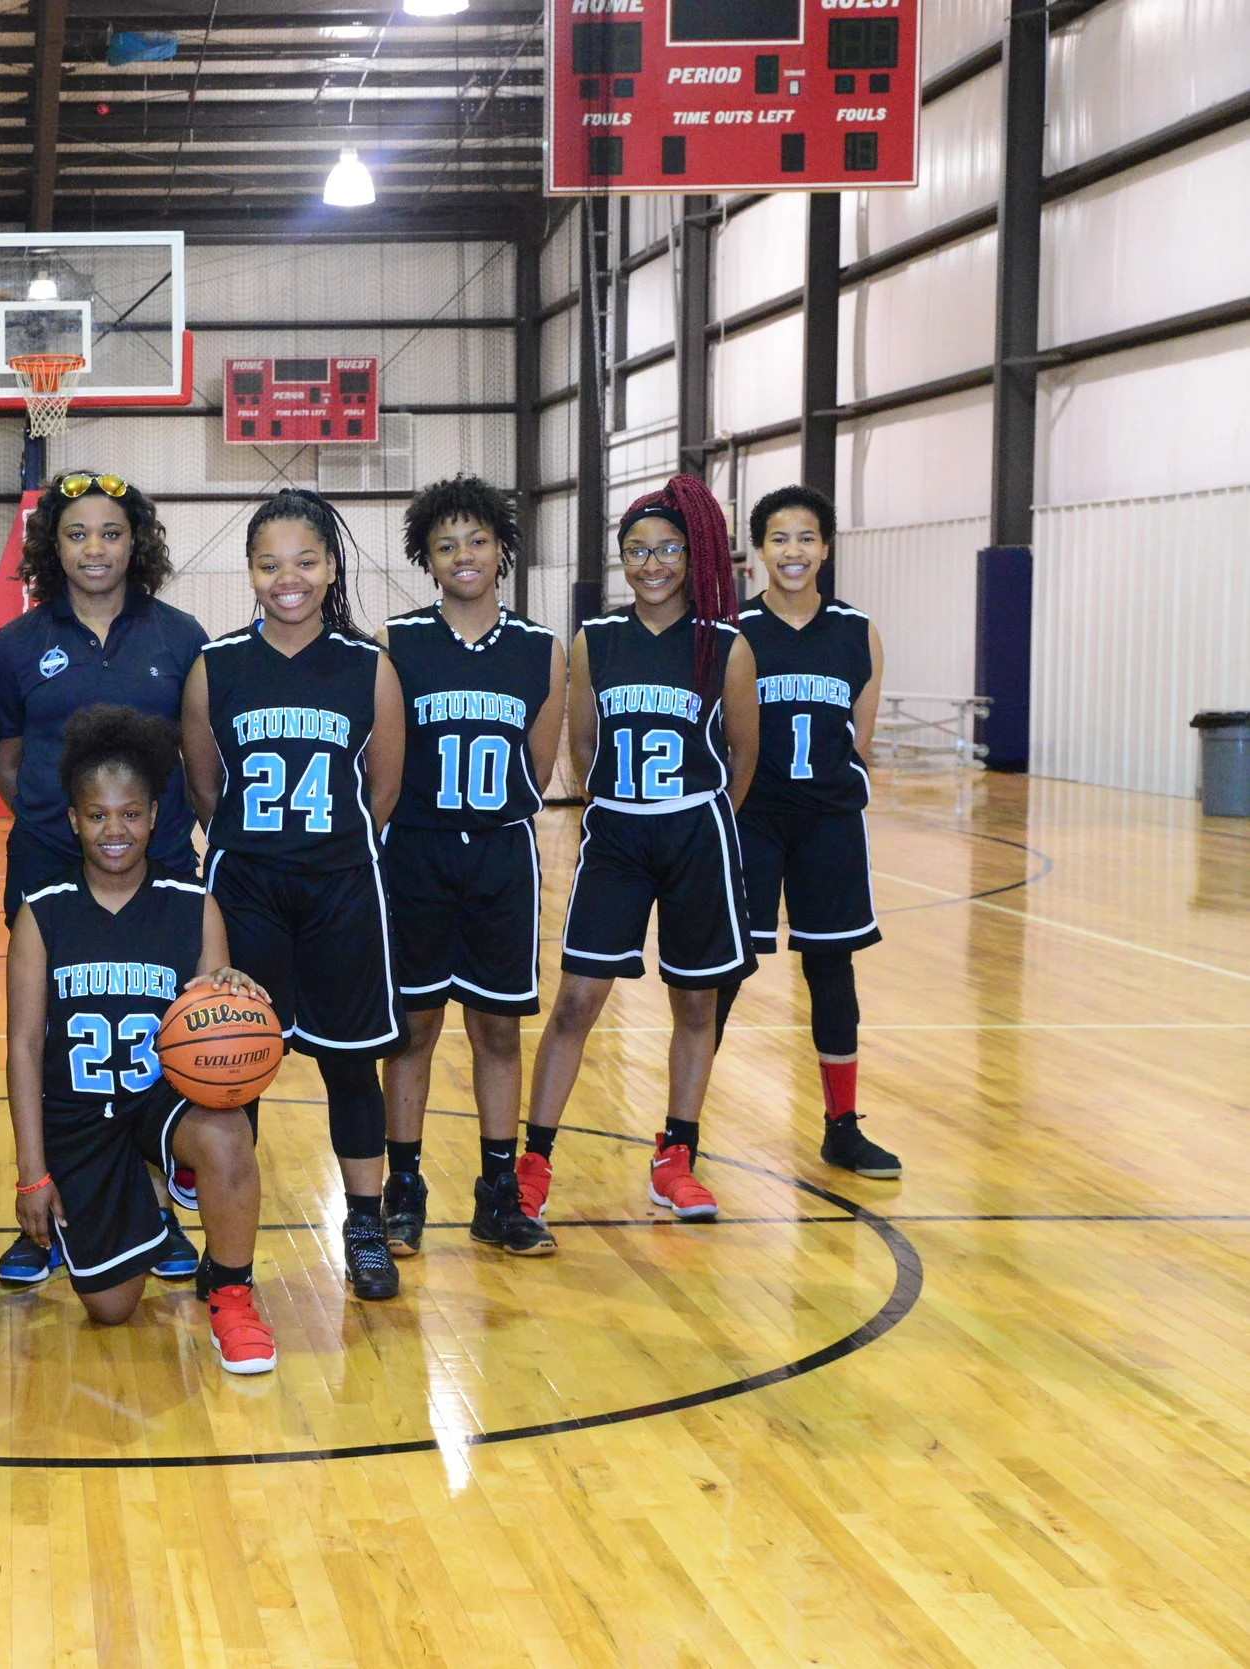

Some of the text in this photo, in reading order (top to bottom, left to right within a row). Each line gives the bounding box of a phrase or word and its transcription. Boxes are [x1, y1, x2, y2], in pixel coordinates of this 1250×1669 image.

[667, 66, 742, 85] PERIOD
[582, 112, 632, 126] FOULS
[673, 109, 796, 125] TIME OUTS LEFT
[836, 107, 887, 121] FOULS
[232, 361, 264, 371] HOME
[336, 360, 372, 370] GUEST
[414, 690, 527, 730] THUNDER
[600, 685, 703, 724] THUNDER
[233, 707, 350, 749] THUNDER
[790, 713, 814, 780] 1
[437, 734, 511, 811] 10
[614, 728, 684, 799] 12
[242, 752, 333, 834] 24
[53, 962, 177, 1001] THUNDER
[183, 1003, 269, 1032] Wilson
[66, 1012, 163, 1095] 23
[194, 1047, 270, 1066] EVOLUTION
